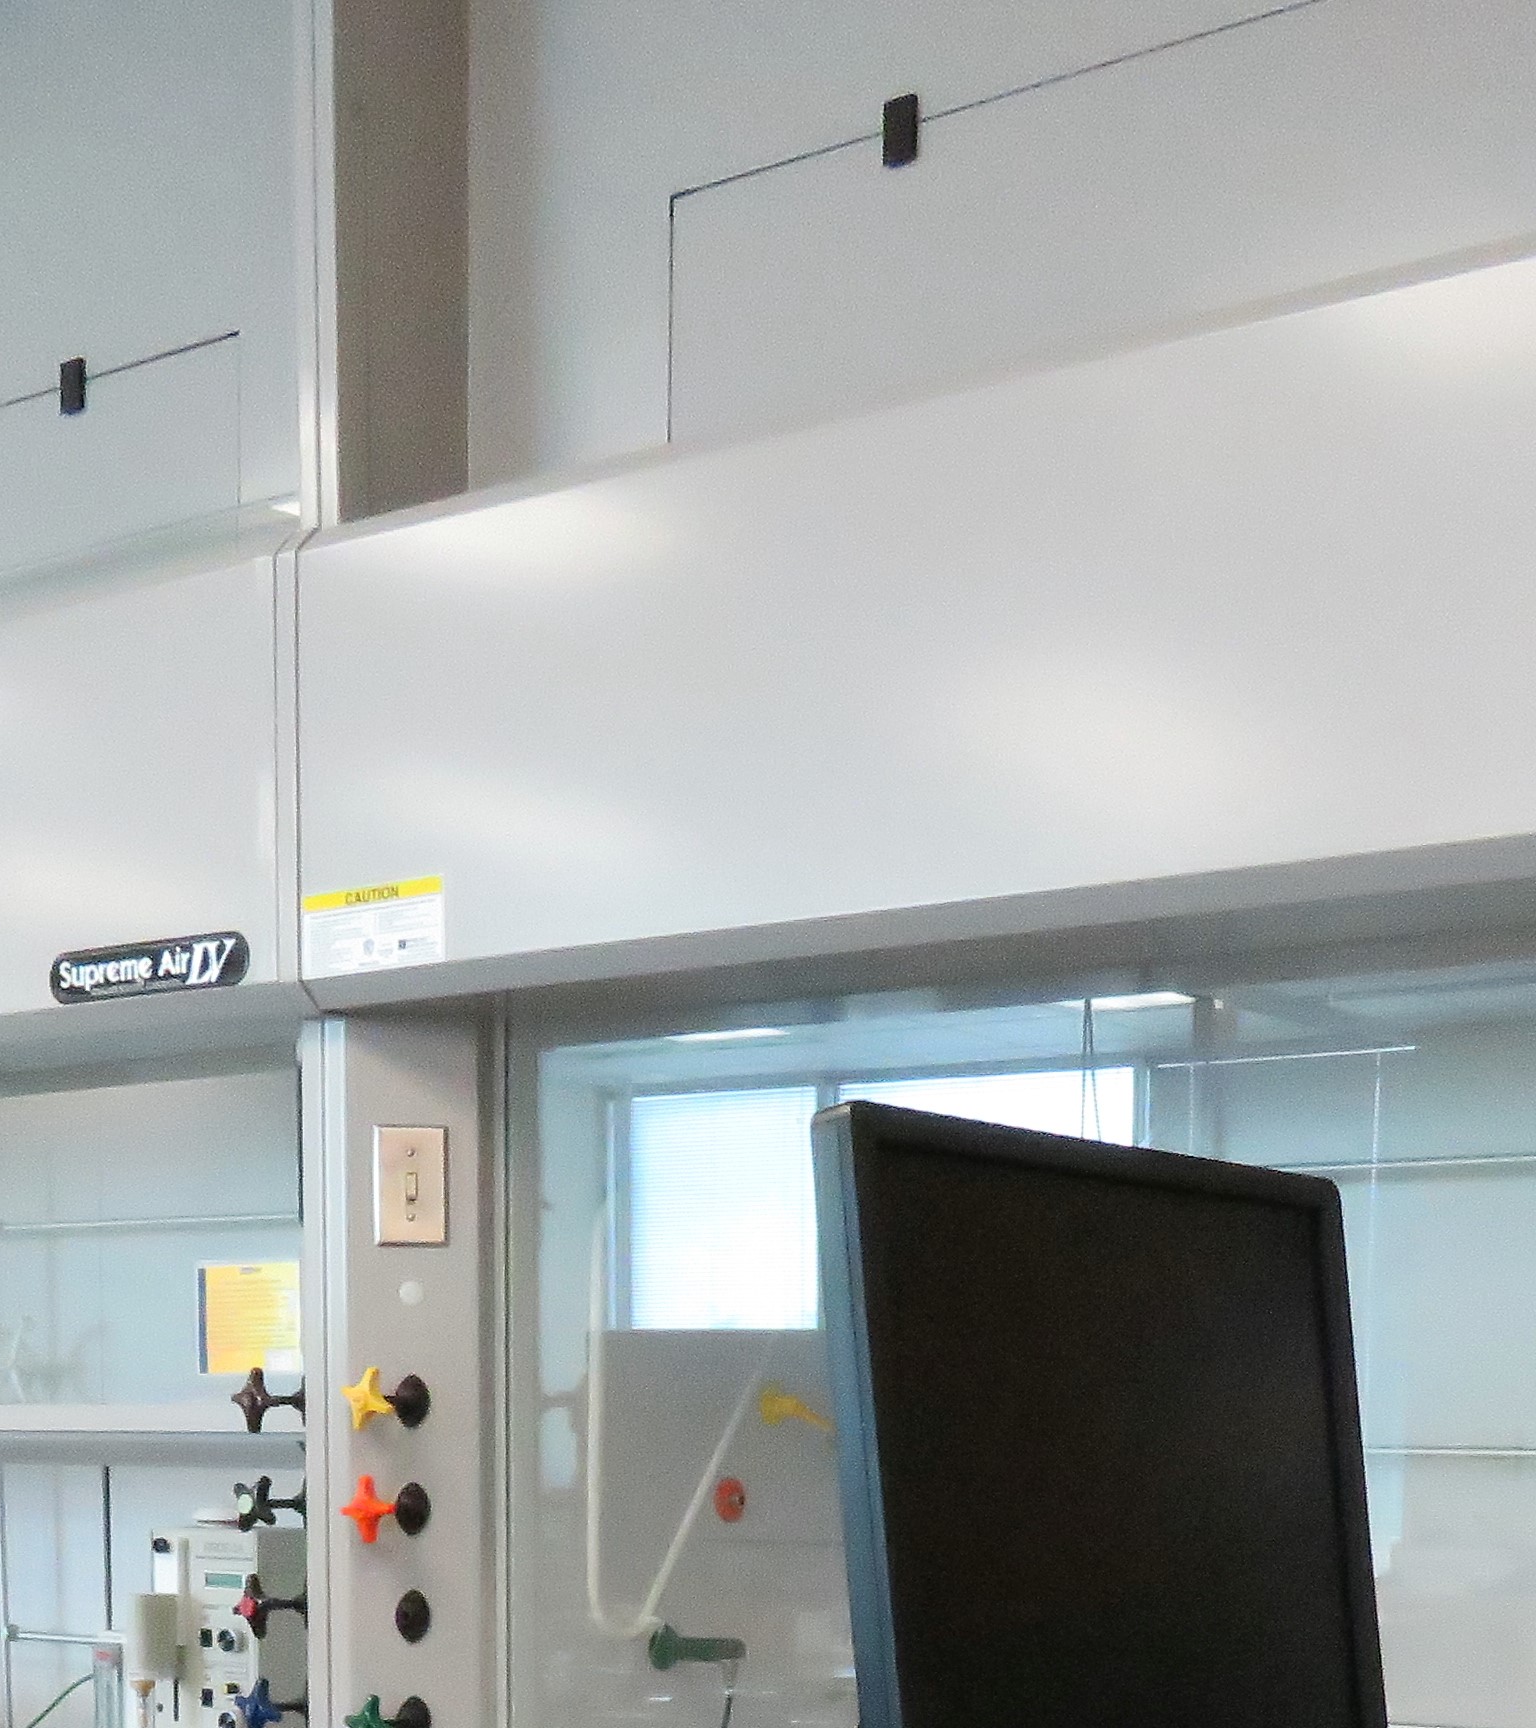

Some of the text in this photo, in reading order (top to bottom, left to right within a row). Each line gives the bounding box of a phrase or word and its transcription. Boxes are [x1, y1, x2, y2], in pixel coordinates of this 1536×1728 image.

[344, 885, 400, 906] CAUTION
[59, 956, 154, 992] Supreme
[158, 945, 191, 978] Air
[184, 937, 237, 986] IV
